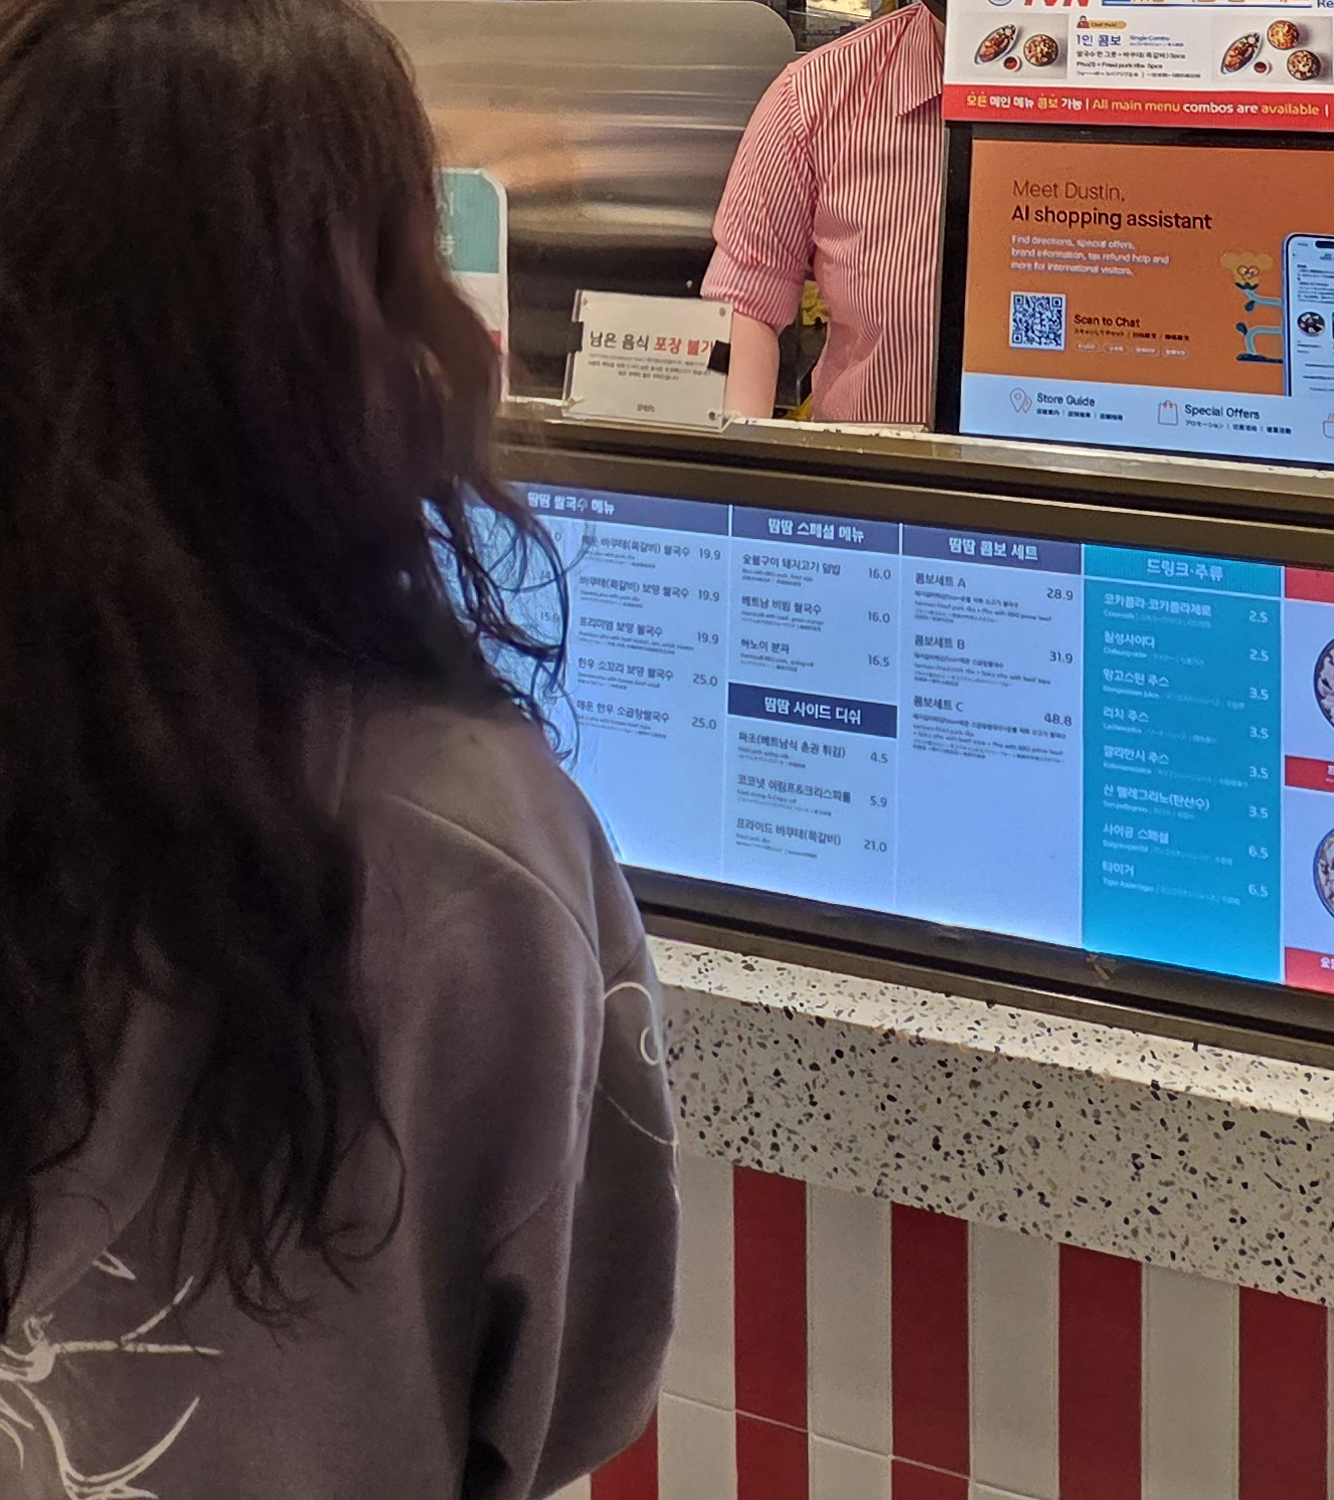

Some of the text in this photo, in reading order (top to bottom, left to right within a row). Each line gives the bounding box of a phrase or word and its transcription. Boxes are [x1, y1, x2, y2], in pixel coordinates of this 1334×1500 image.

[1076, 34, 1121, 47] 1인 콤보
[1061, 97, 1083, 111] 가능
[1092, 98, 1319, 115] All main menu combos are available
[1013, 180, 1125, 202] Meet Dustin,
[1011, 206, 1213, 230] AI shopping assistant
[1074, 314, 1140, 328] Scan to Chat
[590, 330, 617, 349] 남은
[622, 333, 649, 351] 음식
[653, 336, 682, 352] 포장
[1037, 392, 1095, 407] Store Guide
[1185, 404, 1260, 420] Special Offers
[768, 518, 865, 544] 땀땀 스페셜 메뉴
[948, 537, 1039, 561] 땀땀 콤보 세트
[868, 567, 891, 580] 16.0
[915, 572, 1074, 601] 콤보세트 A 28.9
[868, 611, 891, 624] 16.0
[697, 631, 719, 644] 19.9
[740, 638, 769, 652] 하노이
[868, 654, 890, 668] 16.5
[914, 634, 1073, 664] 콤보세트 B 31.9
[1249, 649, 1269, 662] 2.5
[693, 673, 717, 686] 25.0
[764, 696, 861, 726] 땀땀 사이드 디쉬
[913, 695, 1072, 726] 콤보세트 C 48.8
[1249, 726, 1269, 739] 3.5
[870, 795, 888, 808] 5.9
[1248, 845, 1269, 859] 6.5
[1248, 884, 1269, 897] 6.5
